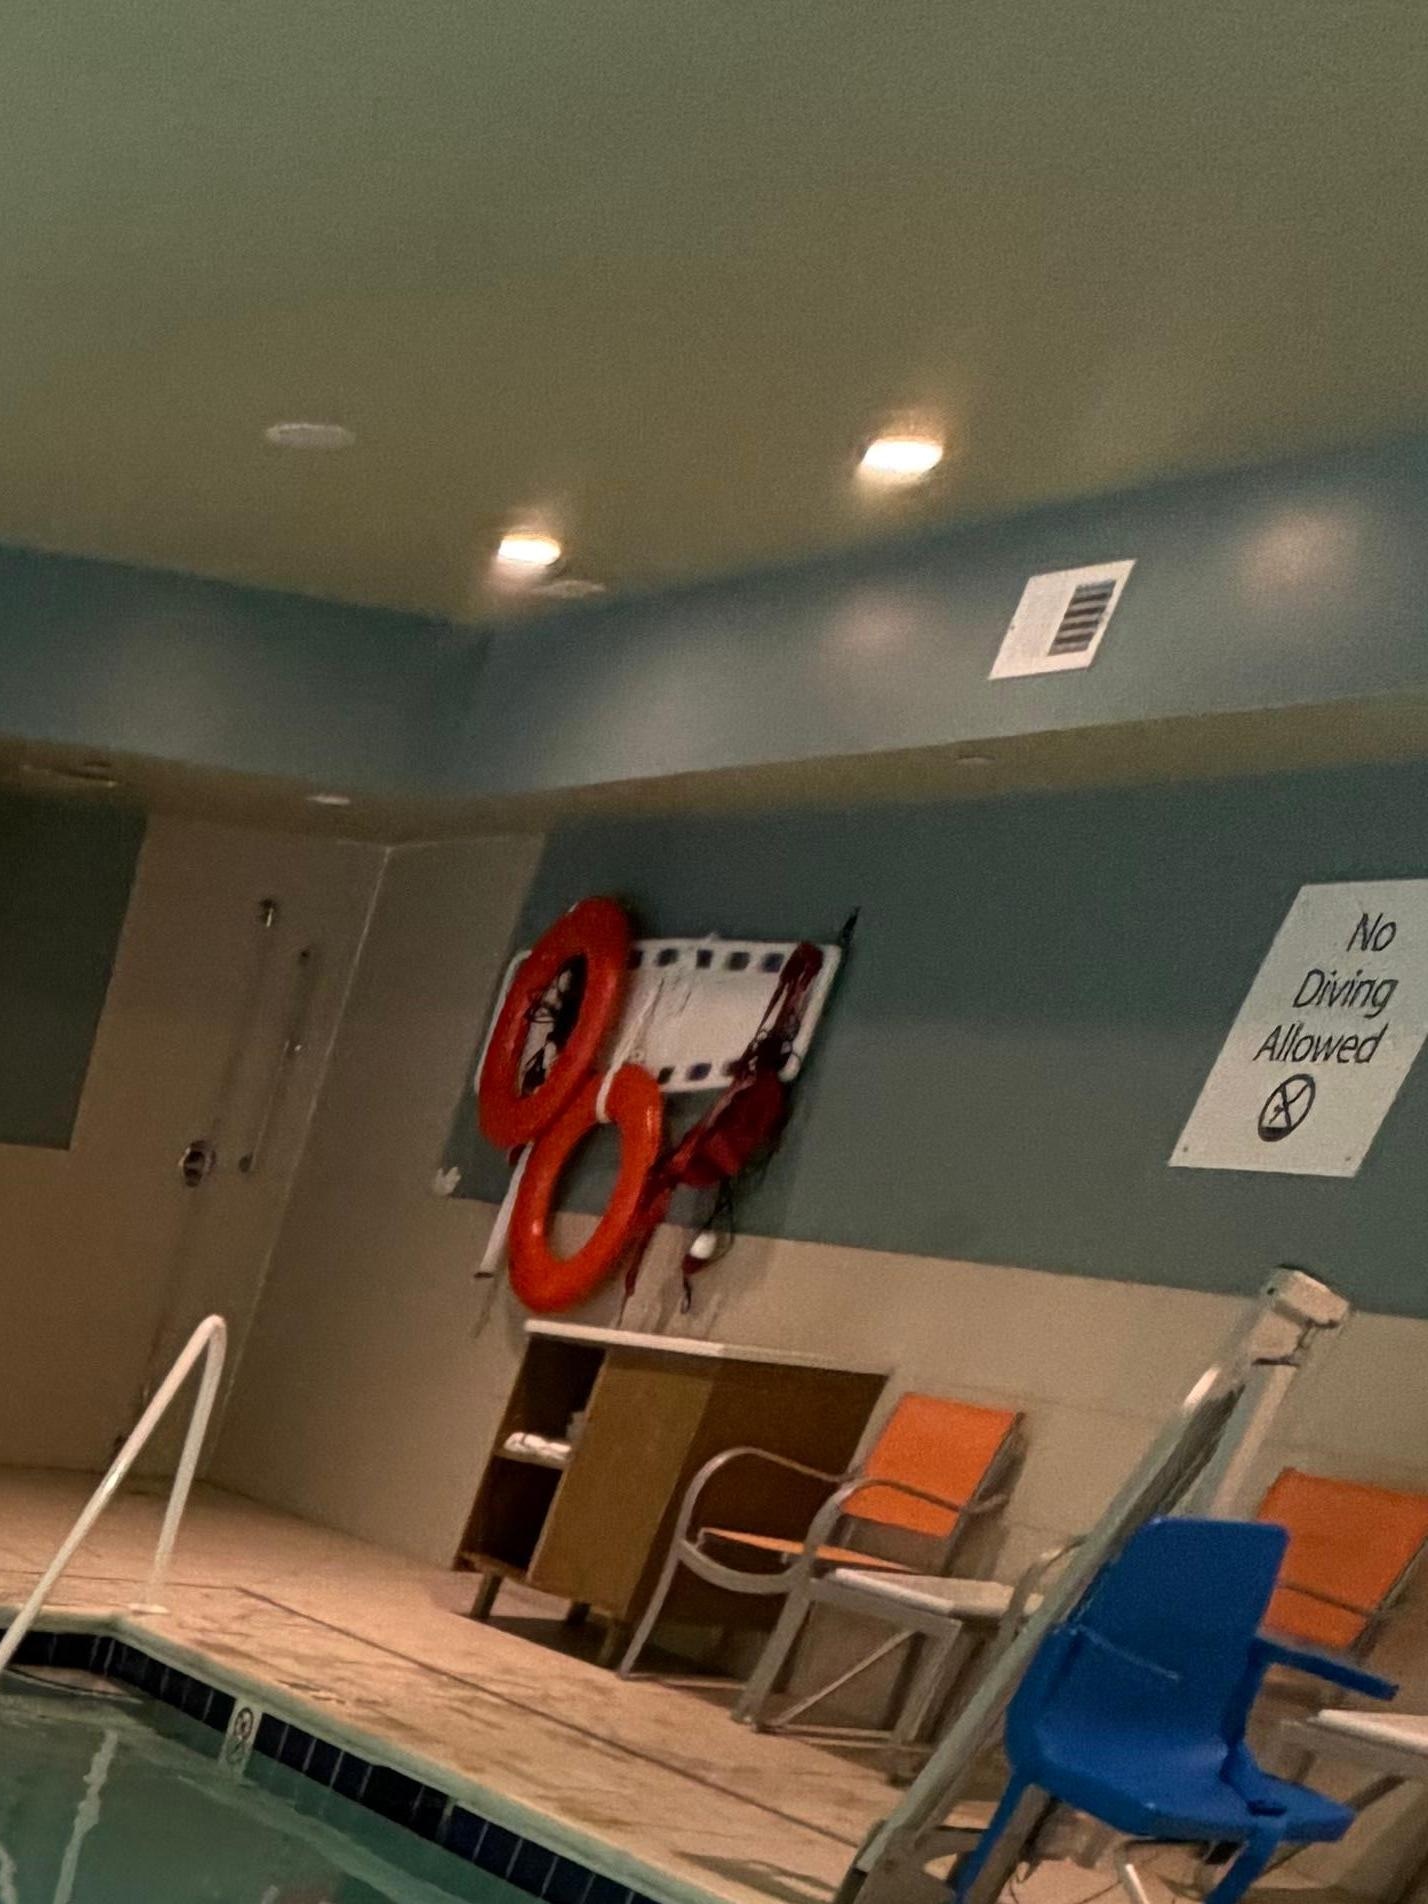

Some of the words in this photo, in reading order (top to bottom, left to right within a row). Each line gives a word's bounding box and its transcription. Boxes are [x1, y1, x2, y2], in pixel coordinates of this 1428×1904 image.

[1347, 912, 1397, 952] No
[1292, 968, 1399, 1019] Diving
[1252, 1020, 1389, 1064] Allowed
